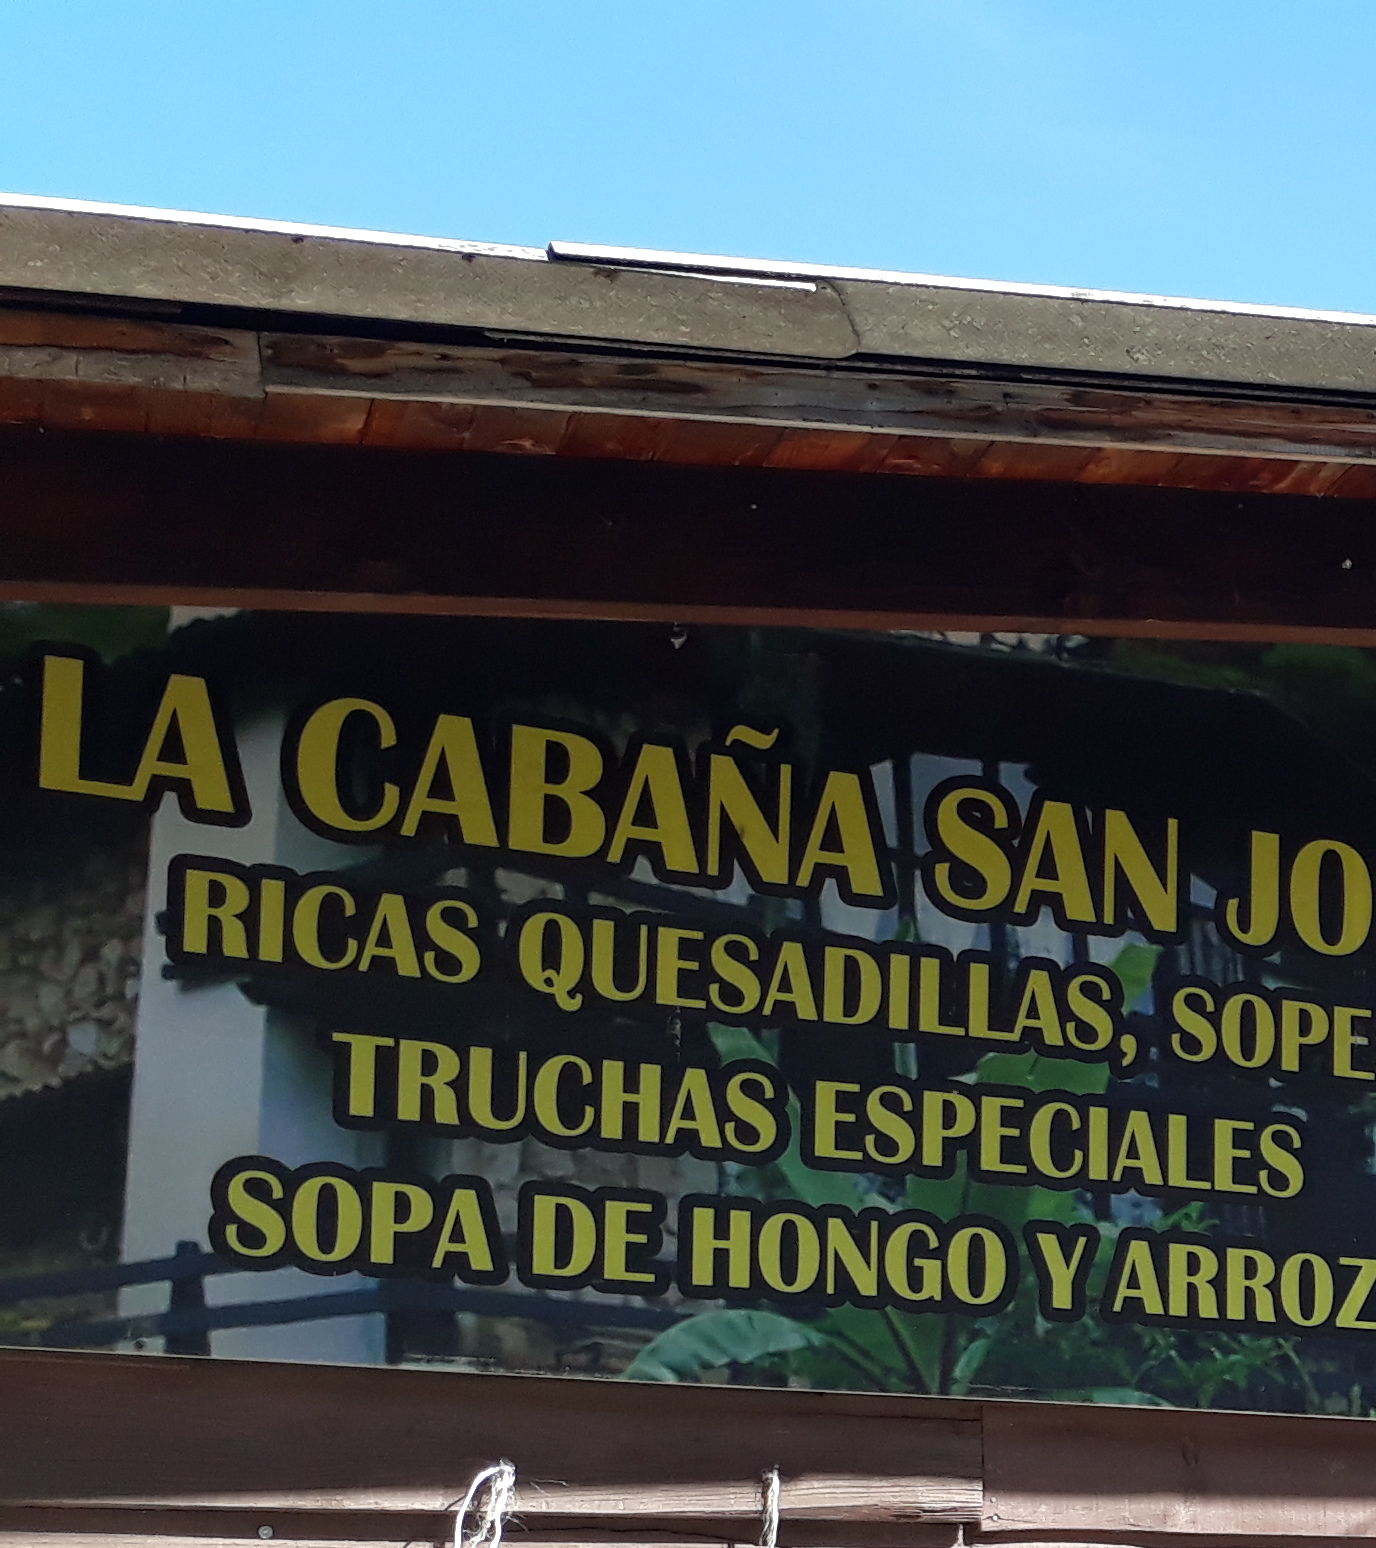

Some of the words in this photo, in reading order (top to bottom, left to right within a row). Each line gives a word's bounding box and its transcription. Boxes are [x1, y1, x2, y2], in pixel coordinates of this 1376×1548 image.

[40, 656, 234, 813] LA
[297, 697, 884, 898] CABAÑA
[935, 787, 1179, 933] SAN
[183, 869, 481, 984] RICAS
[518, 912, 1136, 1067] QUESADILLAS,
[332, 1032, 779, 1154] TRUCHAS
[814, 1080, 1304, 1198] ESPECIALES
[224, 1170, 495, 1273] SOPA
[532, 1194, 659, 1283] DE
[691, 1207, 1006, 1306] HONGO
[1036, 1232, 1088, 1311] Y
